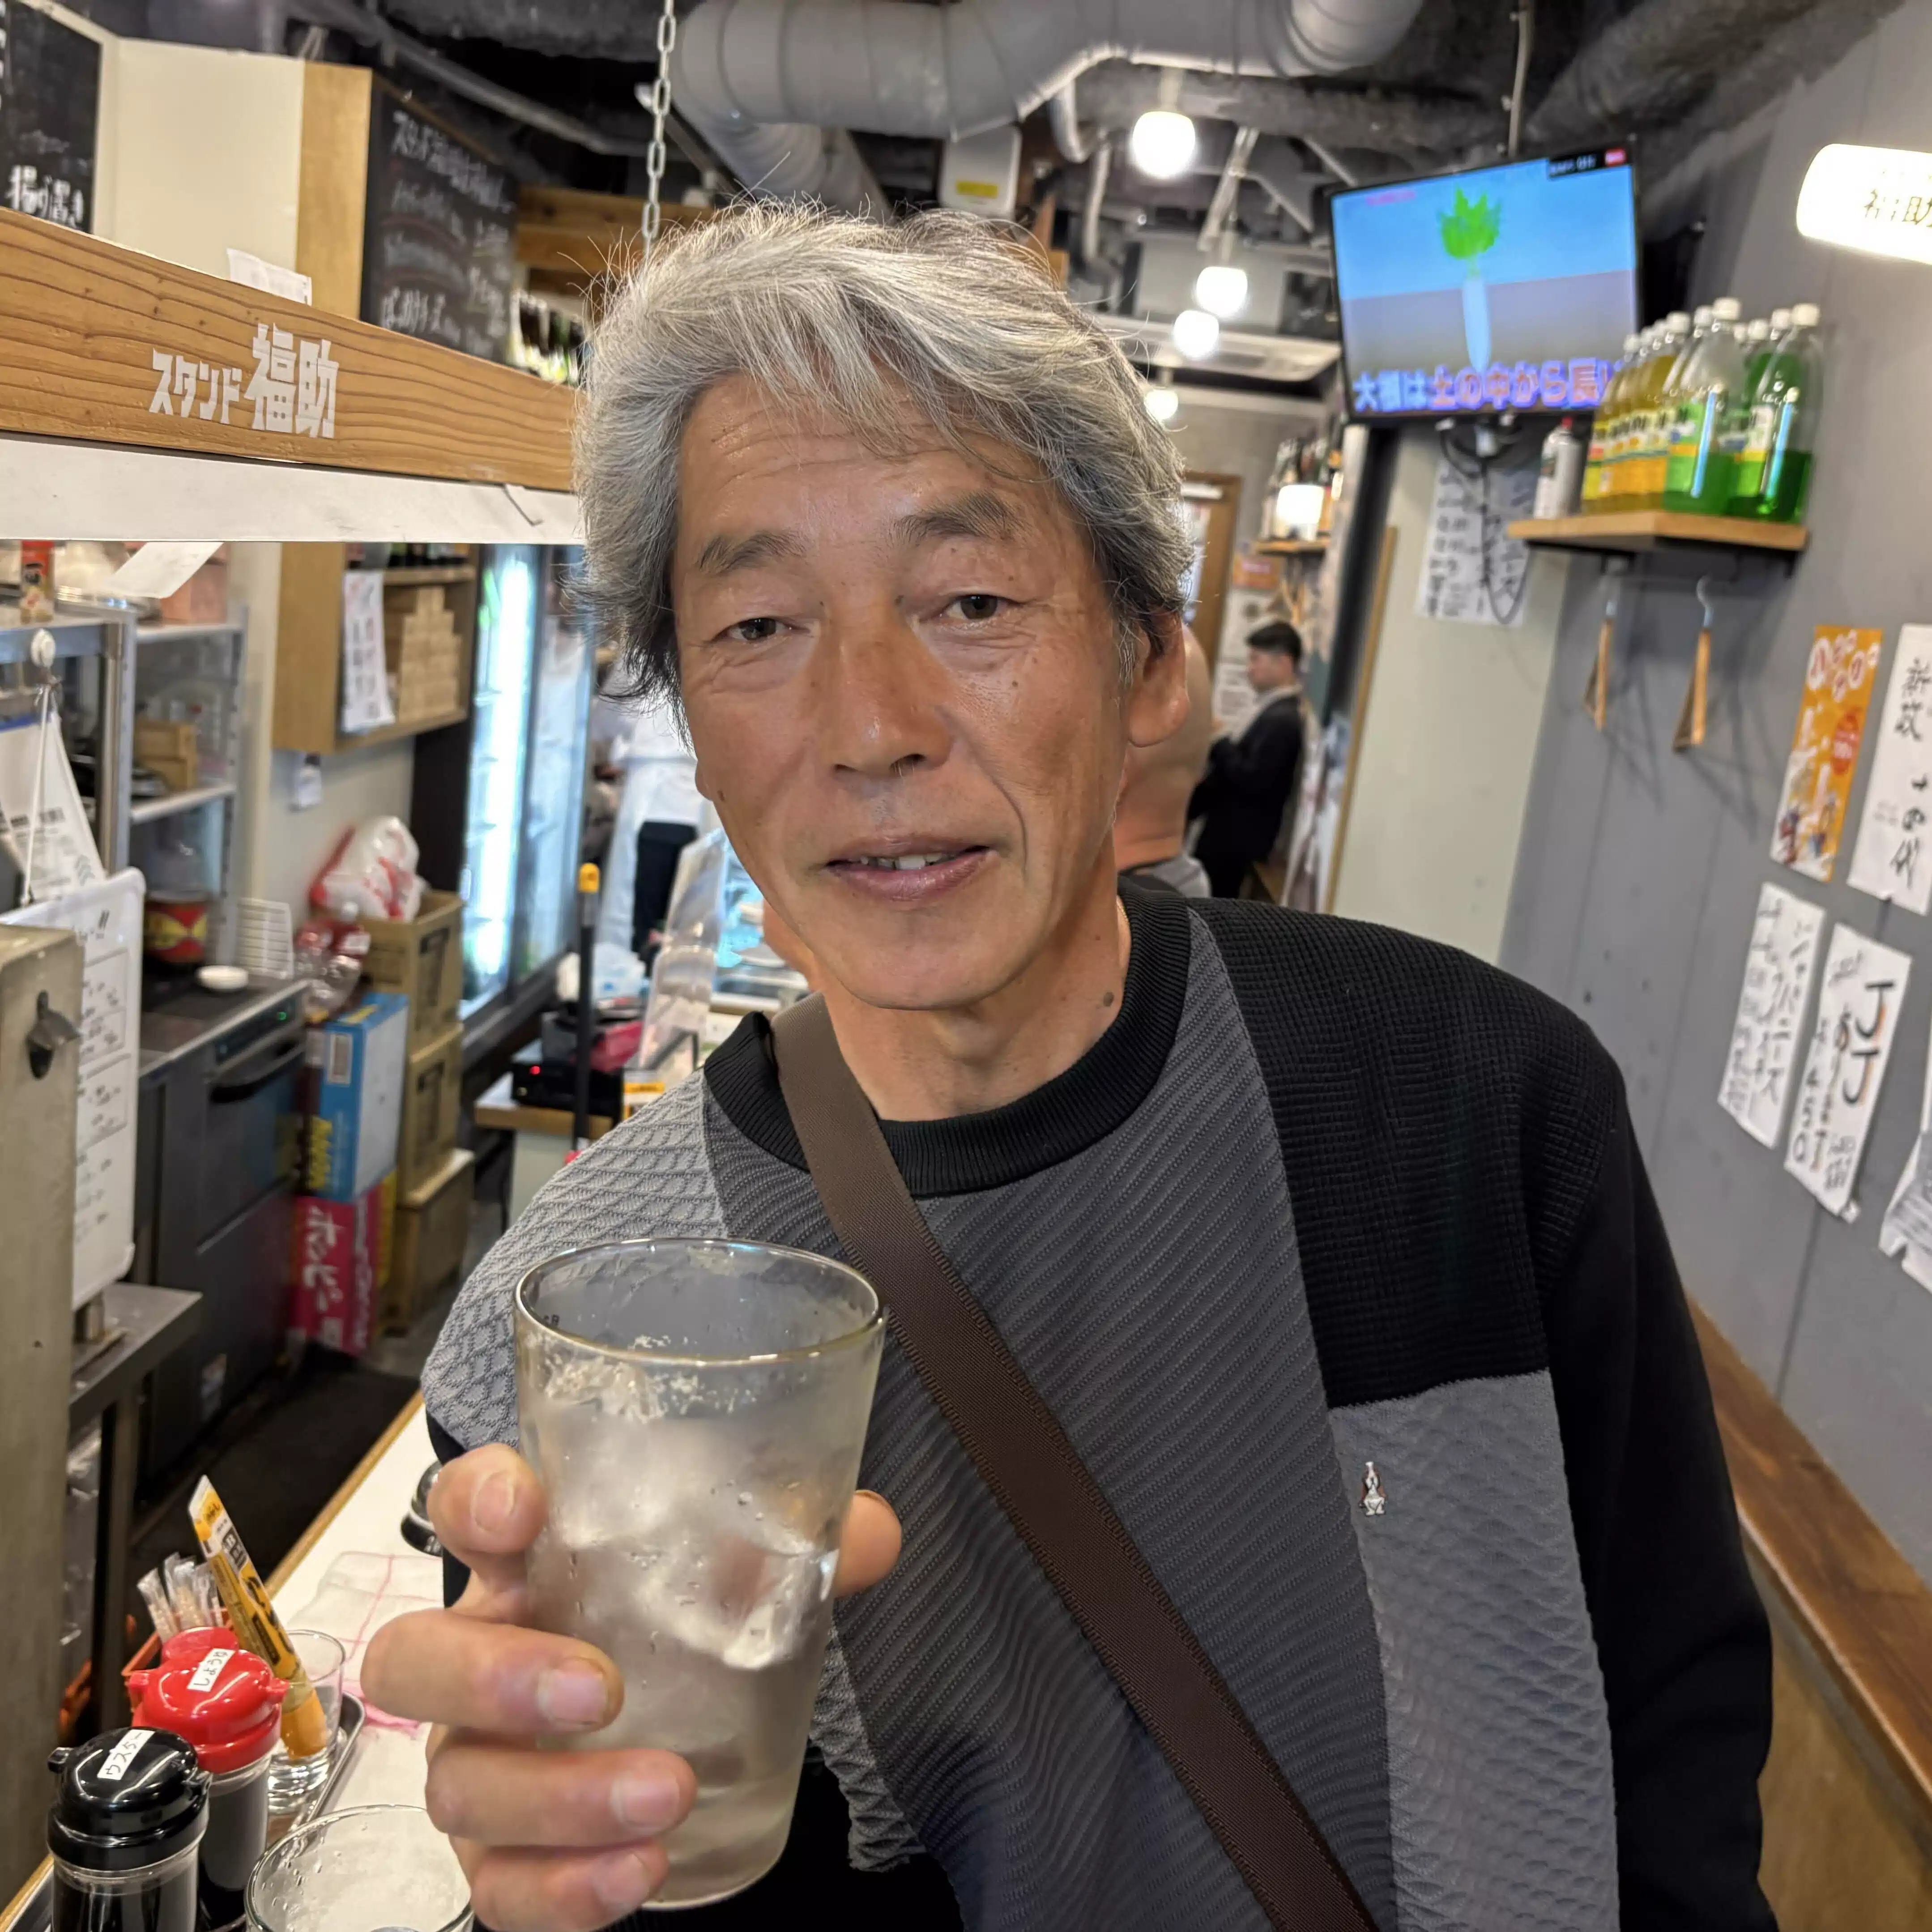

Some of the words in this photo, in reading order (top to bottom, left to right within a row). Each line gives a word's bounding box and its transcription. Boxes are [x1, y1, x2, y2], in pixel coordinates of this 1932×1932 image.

[149, 322, 339, 439] スタンド福助
[194, 1650, 228, 1687] しょうゆ
[105, 1732, 142, 1775] ウスター
